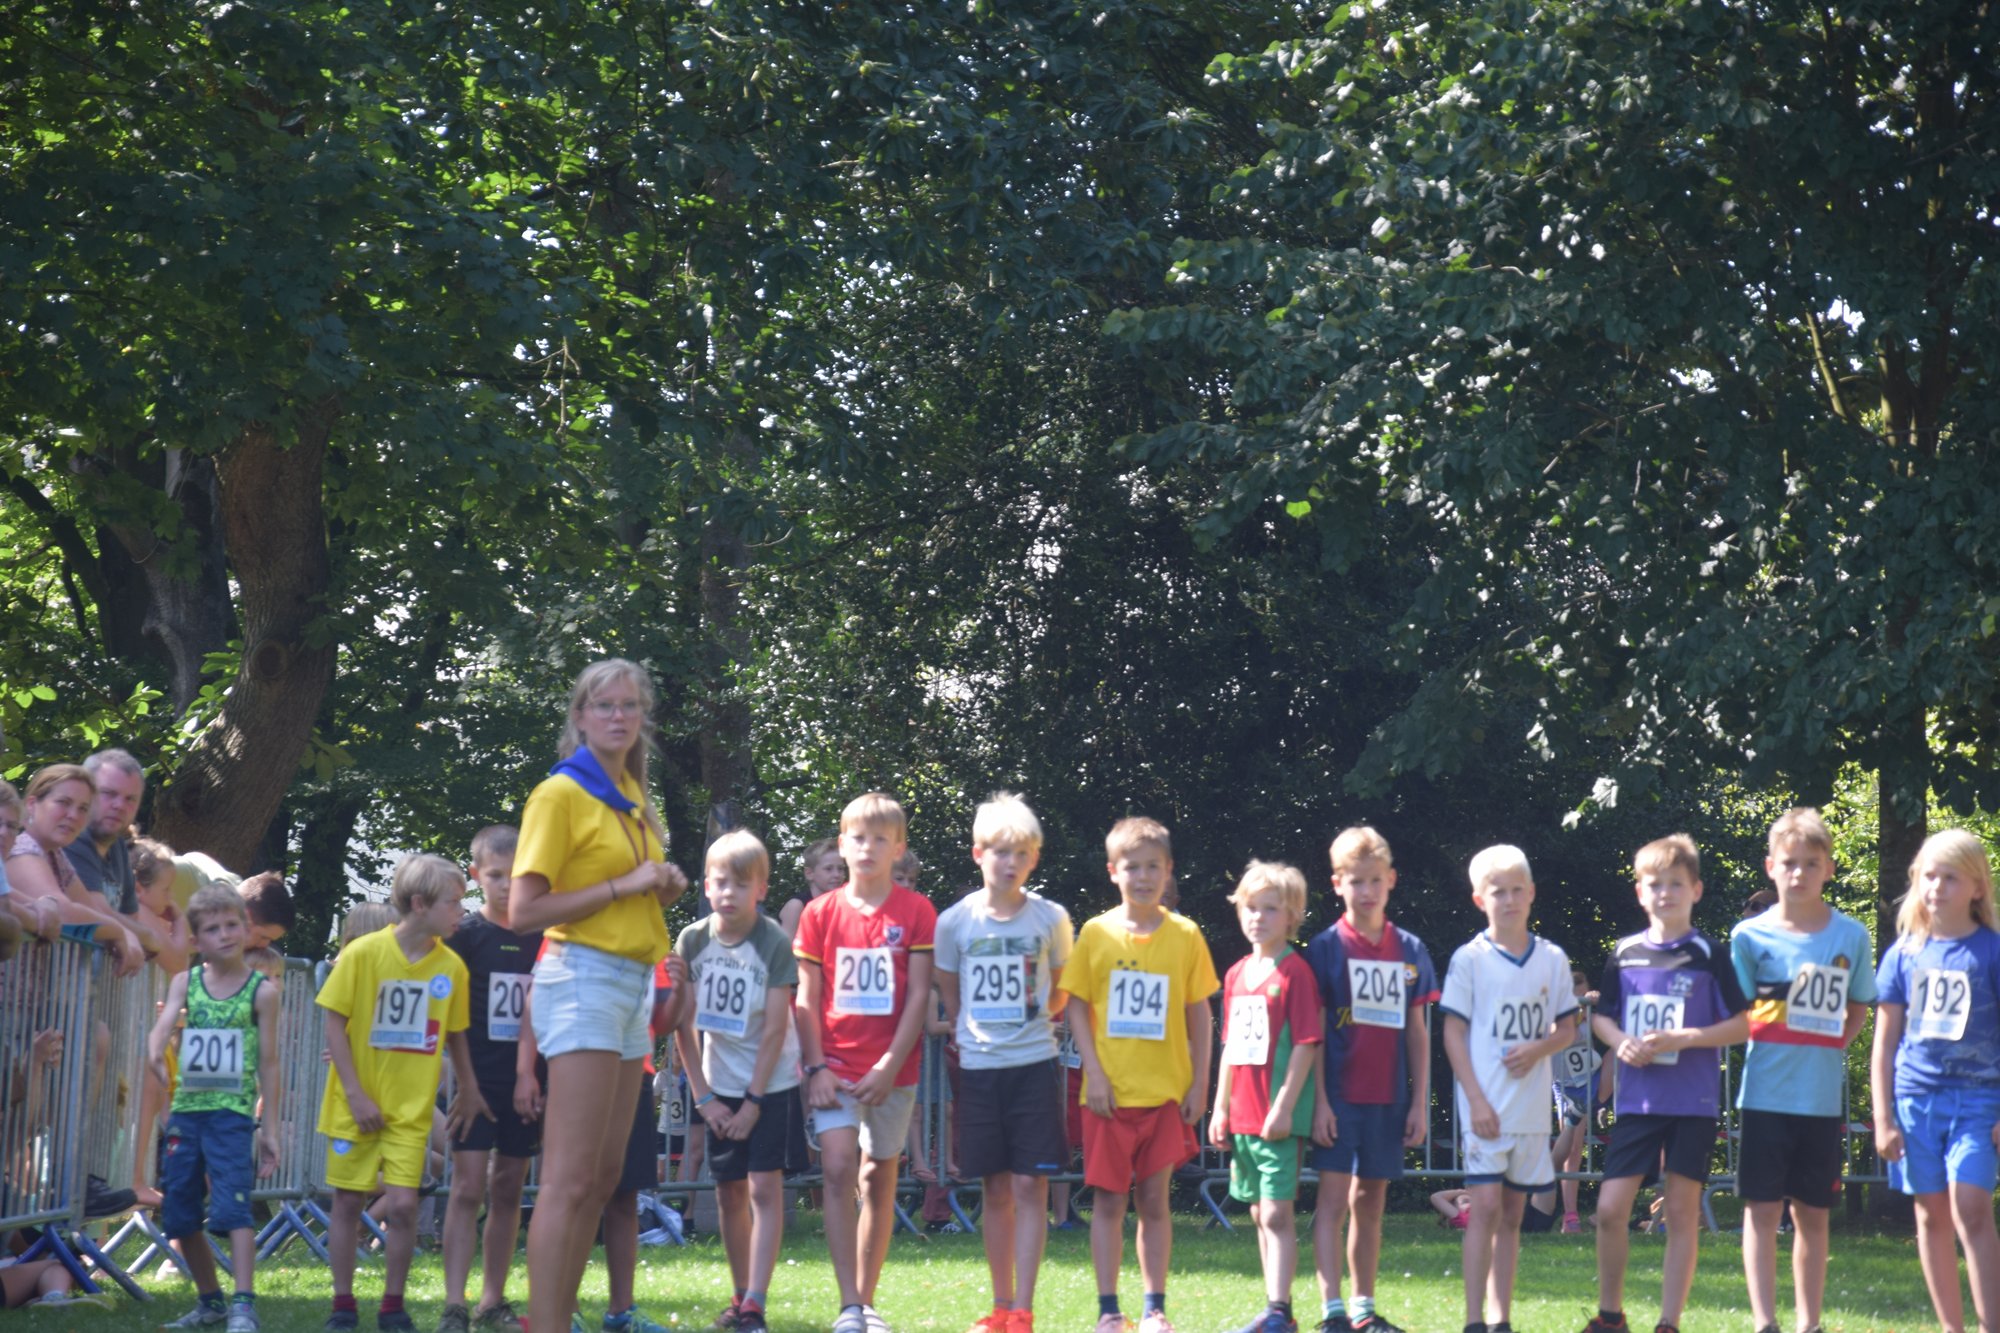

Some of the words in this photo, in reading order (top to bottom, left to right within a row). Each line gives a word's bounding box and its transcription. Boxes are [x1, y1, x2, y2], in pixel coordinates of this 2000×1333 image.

[704, 971, 746, 1015] 198
[840, 955, 888, 992] 206
[972, 964, 1021, 1002] 295
[1354, 967, 1401, 1006] 204
[1791, 971, 1844, 1013] 205
[377, 985, 424, 1026] 197
[493, 980, 532, 1019] 20
[1114, 977, 1163, 1017] 194
[1918, 976, 1966, 1016] 192
[1501, 1002, 1544, 1040] 202
[1631, 1001, 1676, 1038] 196
[188, 1034, 237, 1073] 201
